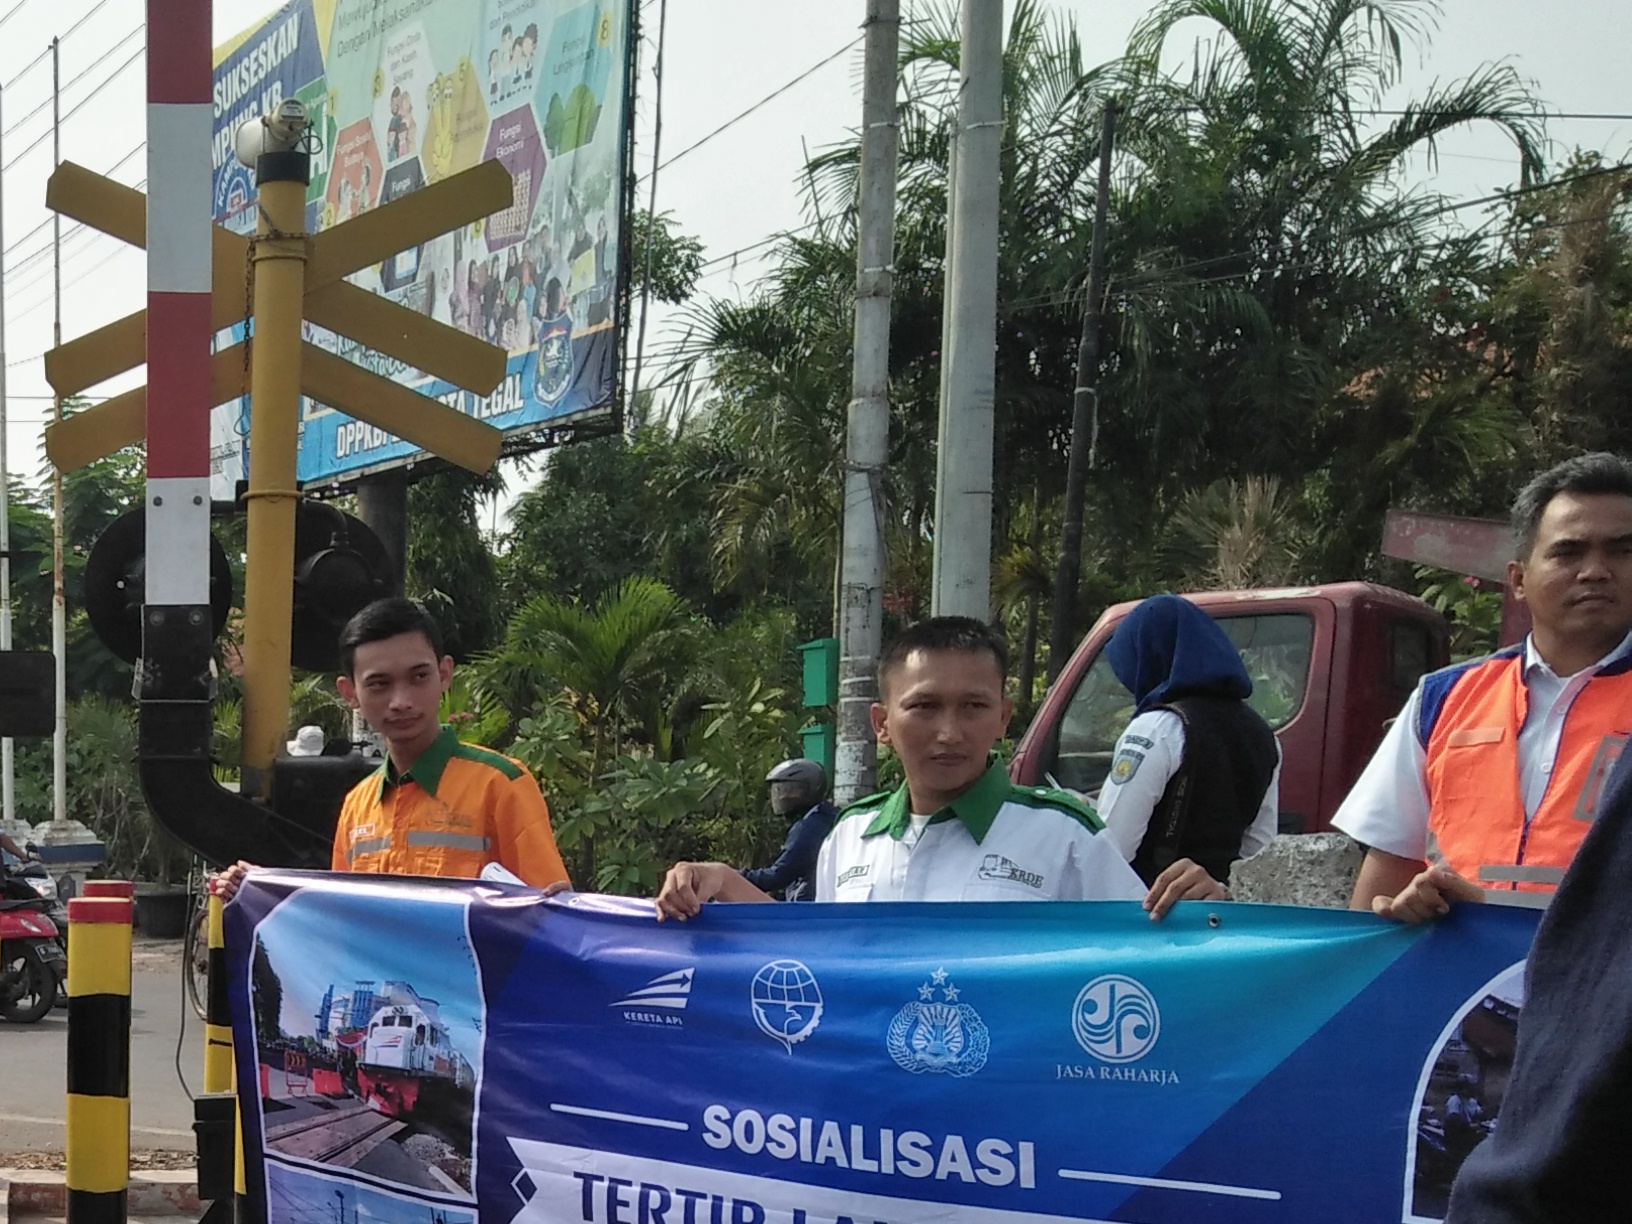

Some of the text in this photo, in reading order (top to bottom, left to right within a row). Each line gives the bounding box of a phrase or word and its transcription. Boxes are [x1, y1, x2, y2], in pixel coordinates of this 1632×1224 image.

[600, 19, 609, 41] 8
[337, 29, 370, 58] Dengan
[212, 12, 300, 119] SUKSESKAN
[499, 123, 521, 141] Fungsi
[496, 139, 525, 158] Ekonomi
[391, 178, 411, 193] Fungsi
[1007, 868, 1045, 887] KRDE
[623, 1011, 663, 1024] KERETA
[665, 1014, 683, 1026] API
[1055, 1063, 1179, 1087] JASA RAHARJA
[701, 1103, 1037, 1190] SOSIALISASI
